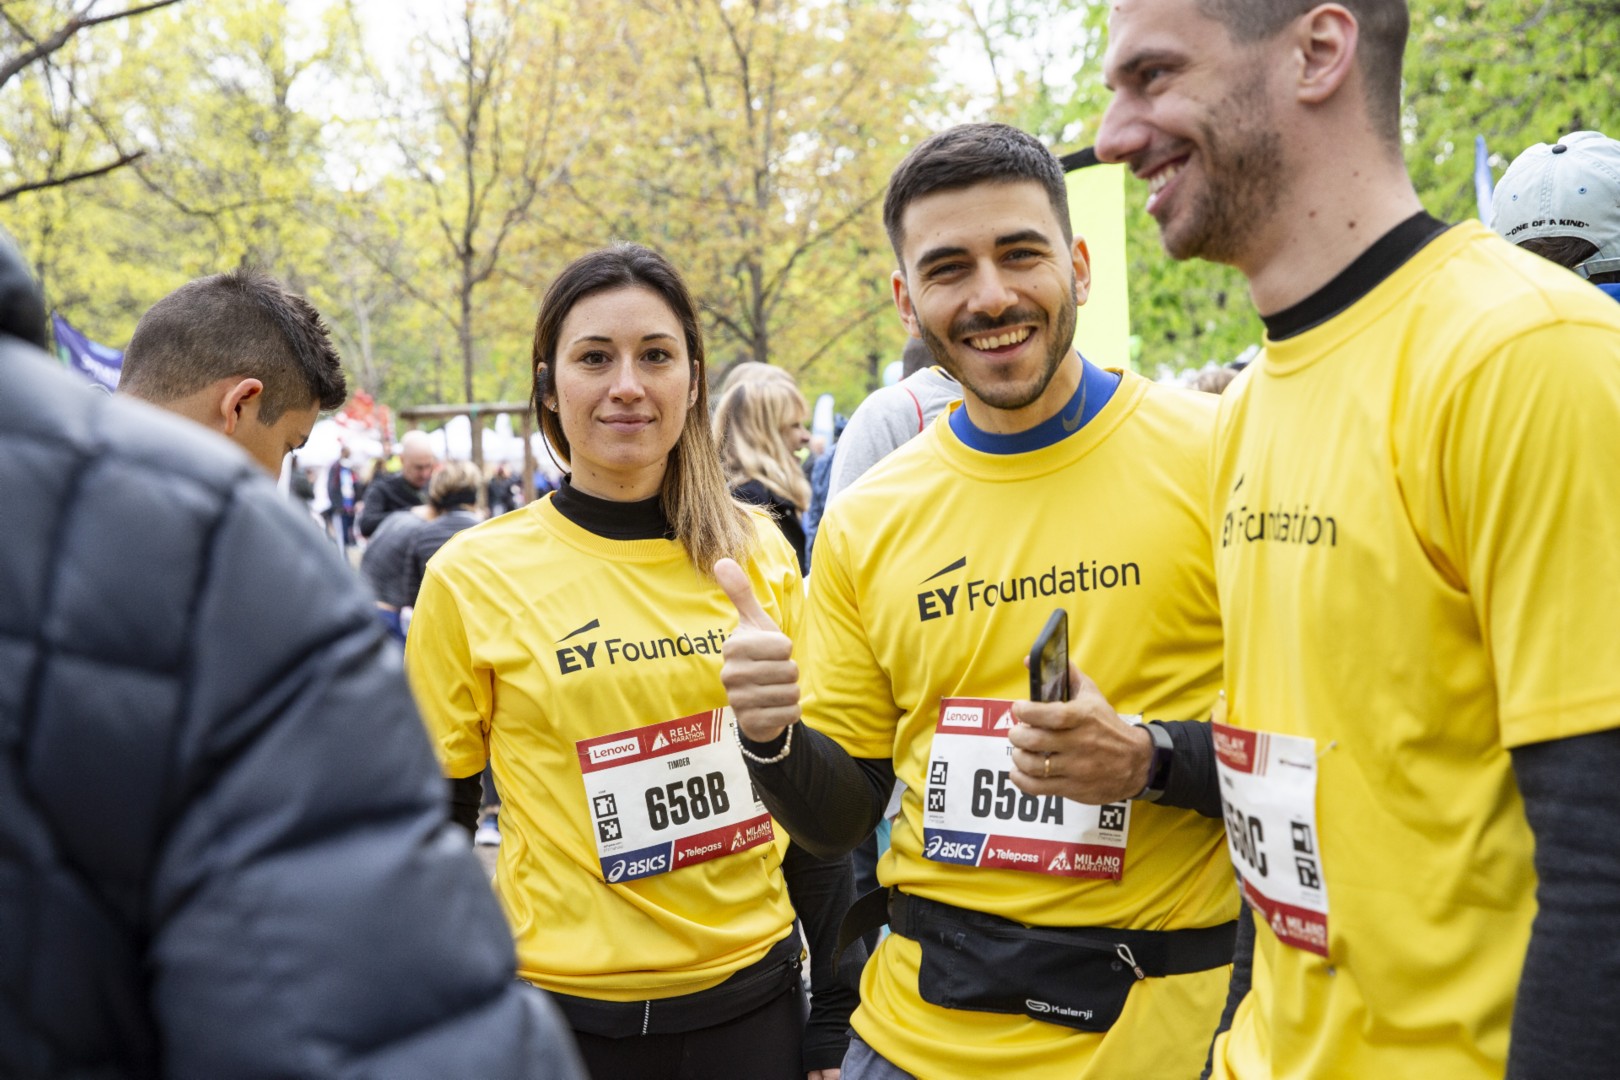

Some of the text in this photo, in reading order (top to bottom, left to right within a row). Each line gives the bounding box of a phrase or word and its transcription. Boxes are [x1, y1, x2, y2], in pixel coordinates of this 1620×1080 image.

[1531, 219, 1547, 227] OF
[917, 560, 1141, 622] EY Foundation
[555, 629, 733, 676] EY Foundati
[945, 709, 979, 722] Lenovo
[669, 722, 703, 738] RELAY
[671, 730, 706, 744] MARATHON
[593, 743, 636, 759] Lenovo
[644, 770, 730, 832] 658B
[970, 768, 1064, 825] 658A
[745, 820, 770, 836] MILANO
[684, 841, 722, 859] Telepass
[996, 848, 1040, 864] Telepass
[1073, 863, 1120, 873] MARATHON
[1074, 853, 1120, 867] MILANO
[1052, 1004, 1093, 1020] Kalenji
